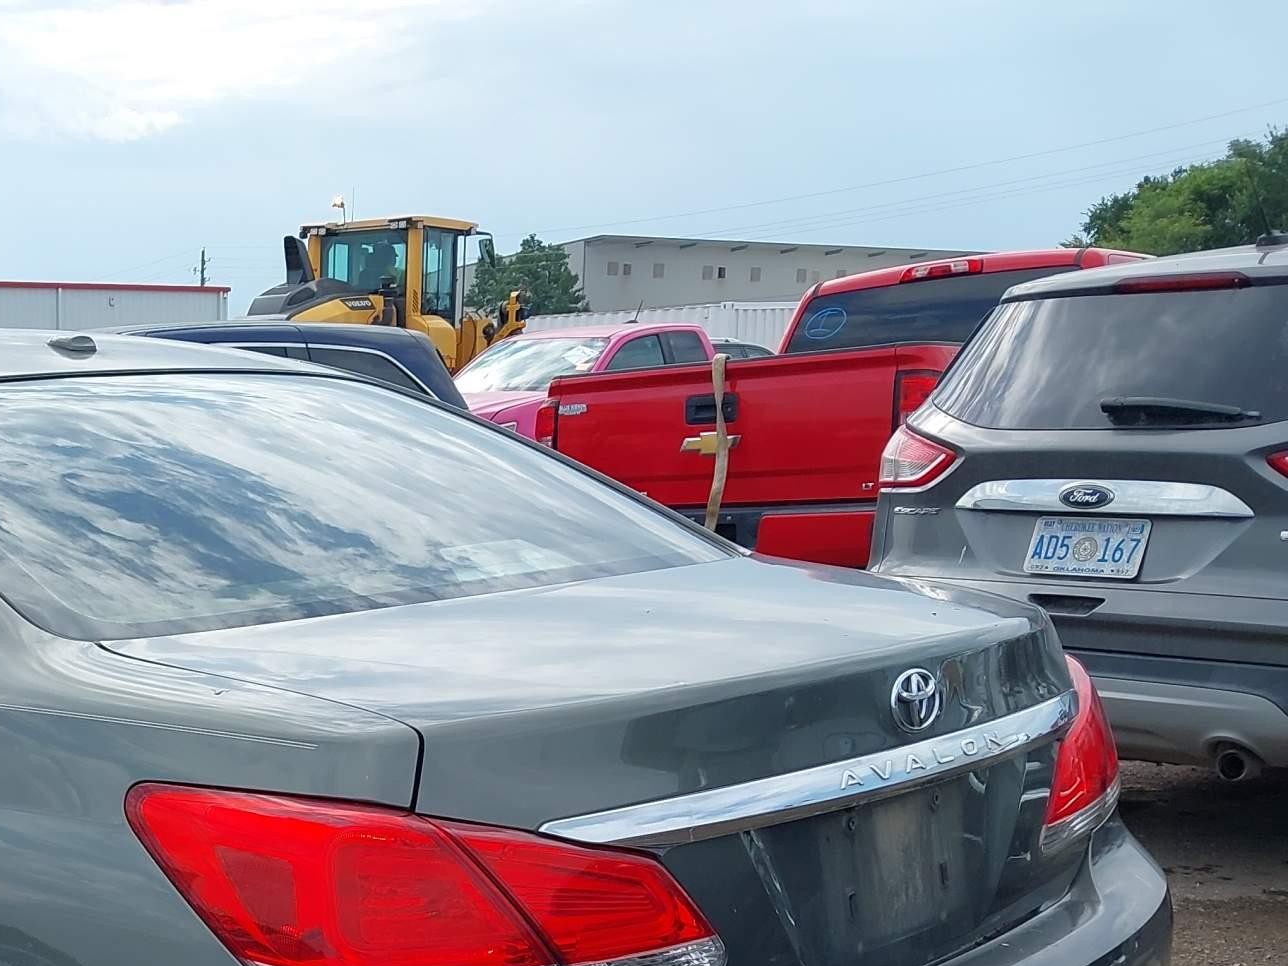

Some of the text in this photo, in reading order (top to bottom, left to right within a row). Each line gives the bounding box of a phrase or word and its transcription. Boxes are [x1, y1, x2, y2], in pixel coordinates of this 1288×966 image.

[1069, 489, 1100, 503] Ford
[1031, 535, 1141, 563] AD5 167
[1053, 566, 1105, 574] OKLAHOMA
[840, 730, 1003, 790] AVALON
